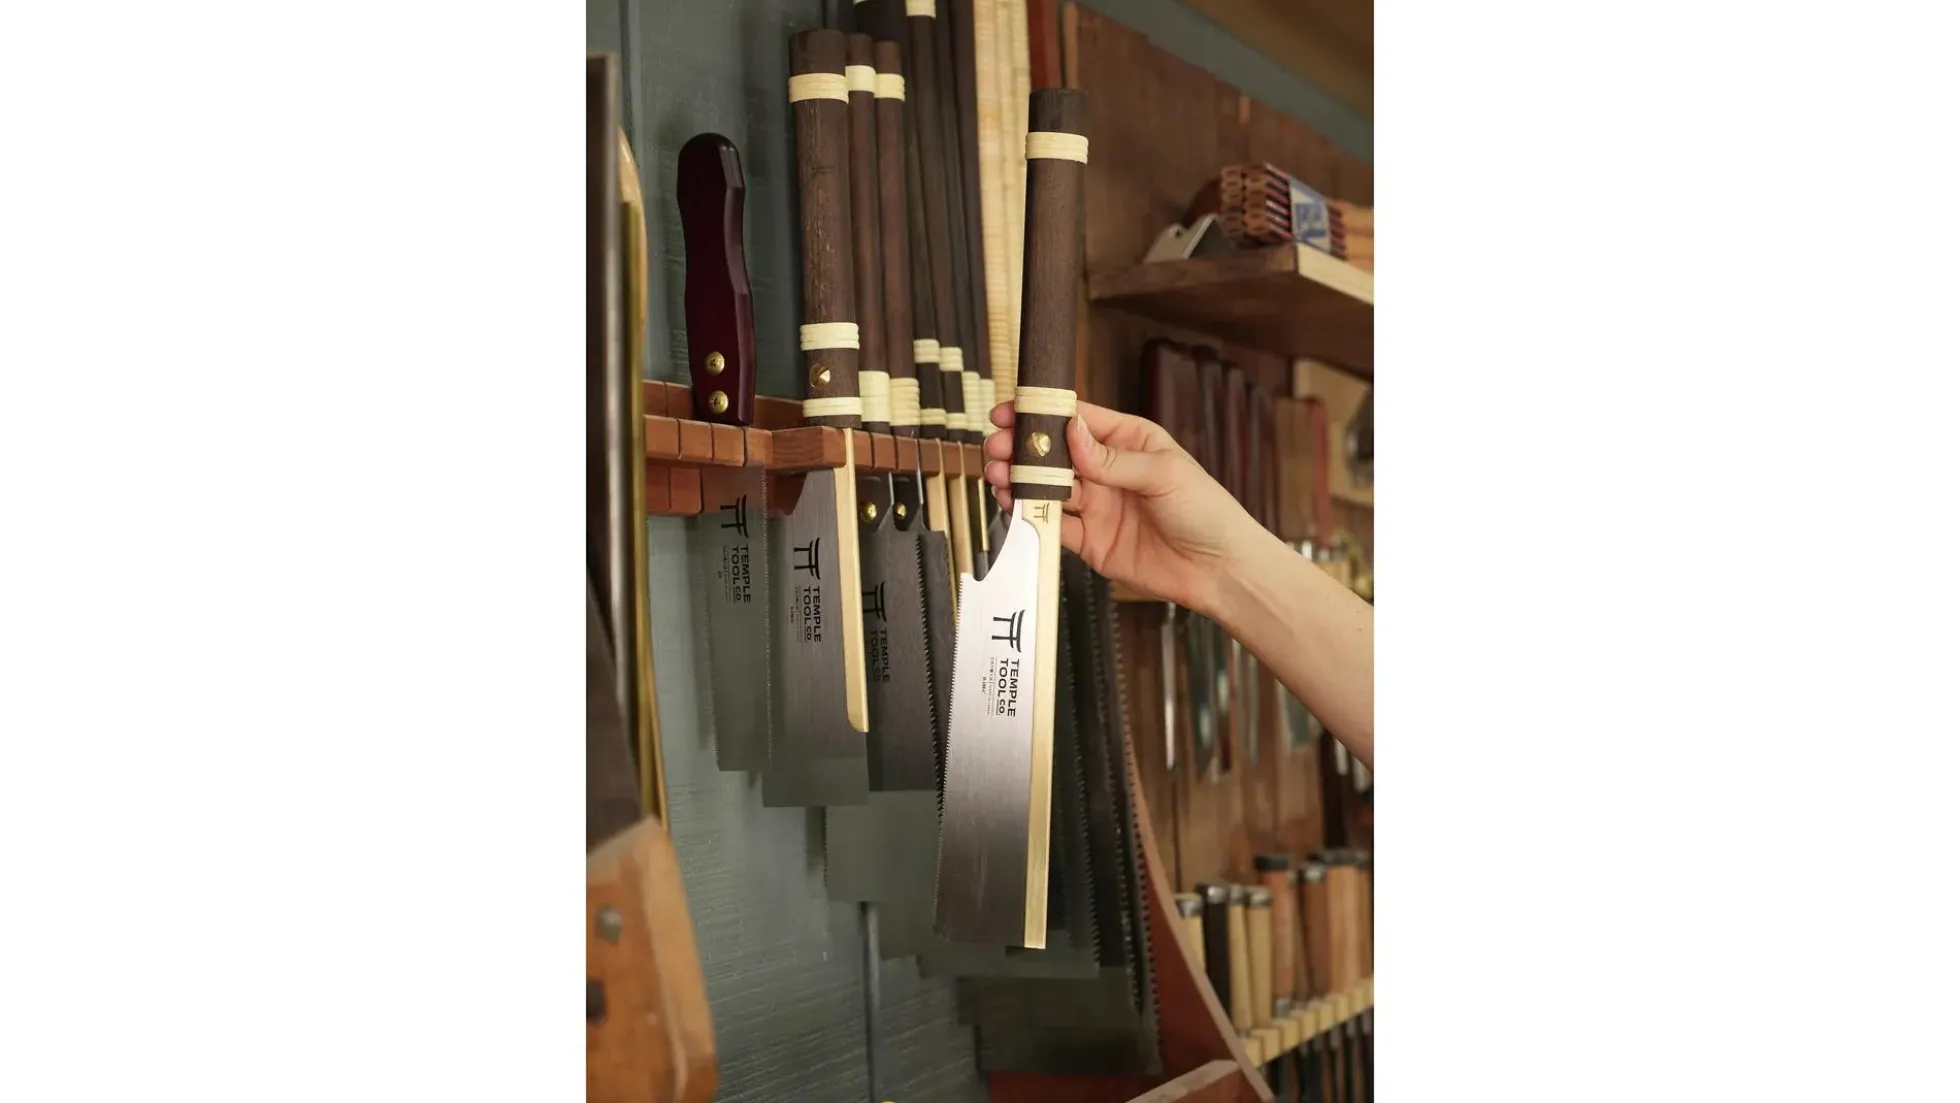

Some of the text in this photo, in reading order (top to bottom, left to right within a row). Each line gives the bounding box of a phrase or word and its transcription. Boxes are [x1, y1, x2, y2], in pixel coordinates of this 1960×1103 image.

[731, 545, 740, 585] TOOL
[740, 544, 751, 604] TEMPLE
[803, 586, 811, 625] TOOL
[812, 586, 821, 643] TEMPLE
[880, 628, 890, 683] TEMPLE
[998, 658, 1009, 698] TOOL
[1007, 658, 1020, 718] TEMPLE
